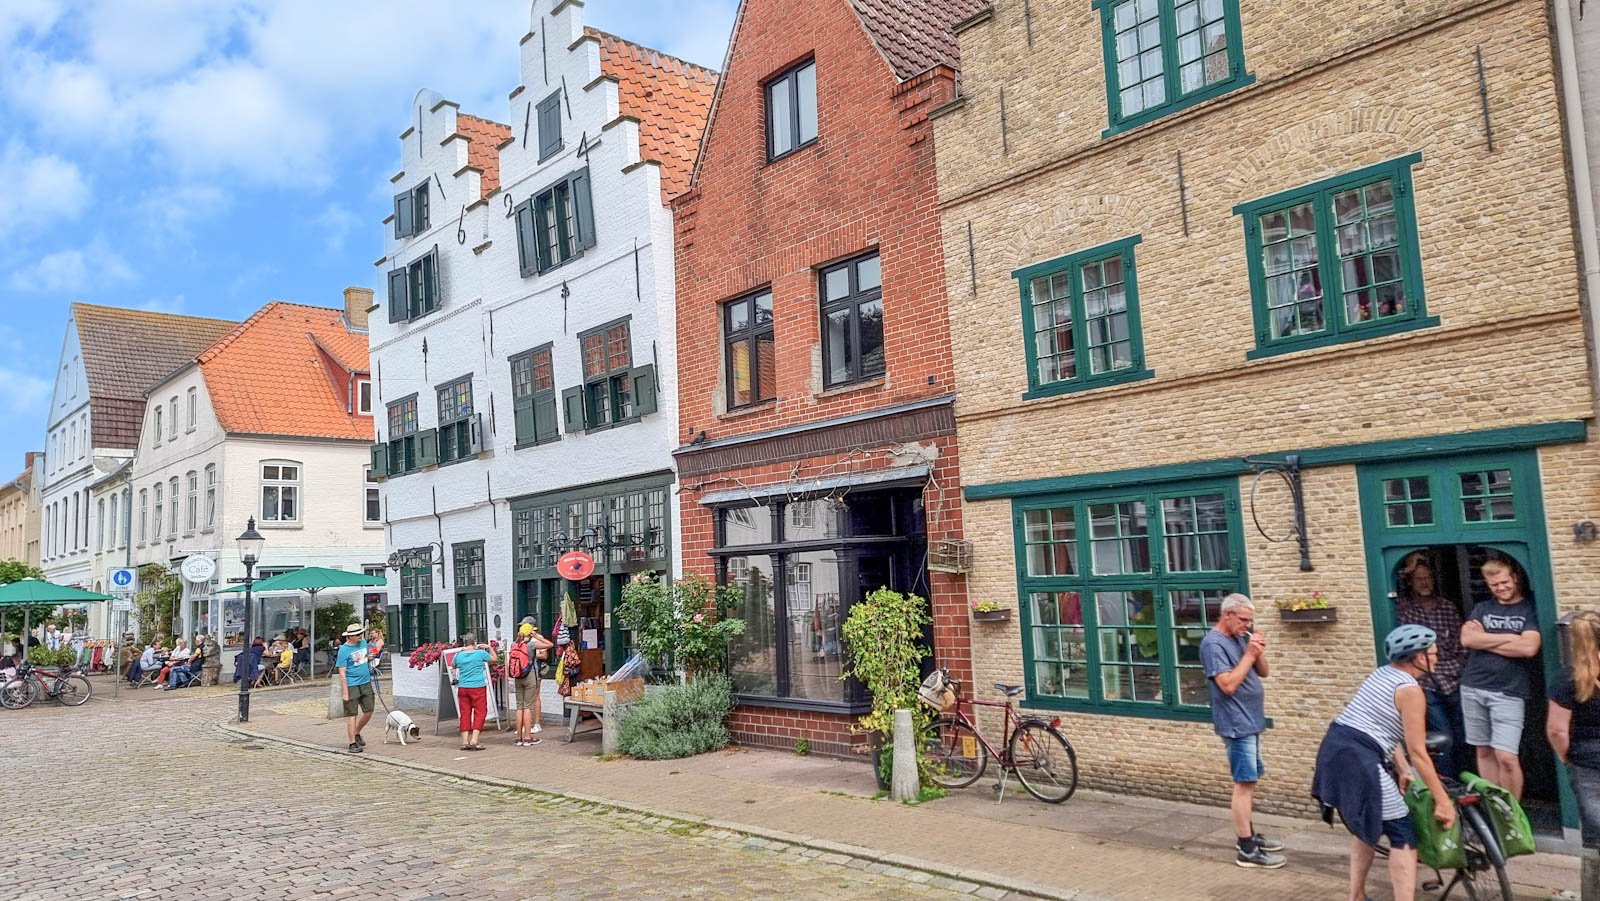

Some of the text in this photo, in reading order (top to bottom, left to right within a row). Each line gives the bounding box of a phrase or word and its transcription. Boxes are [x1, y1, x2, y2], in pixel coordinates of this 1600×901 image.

[457, 131, 602, 245] 6 2 4
[1483, 614, 1527, 632] Norton
